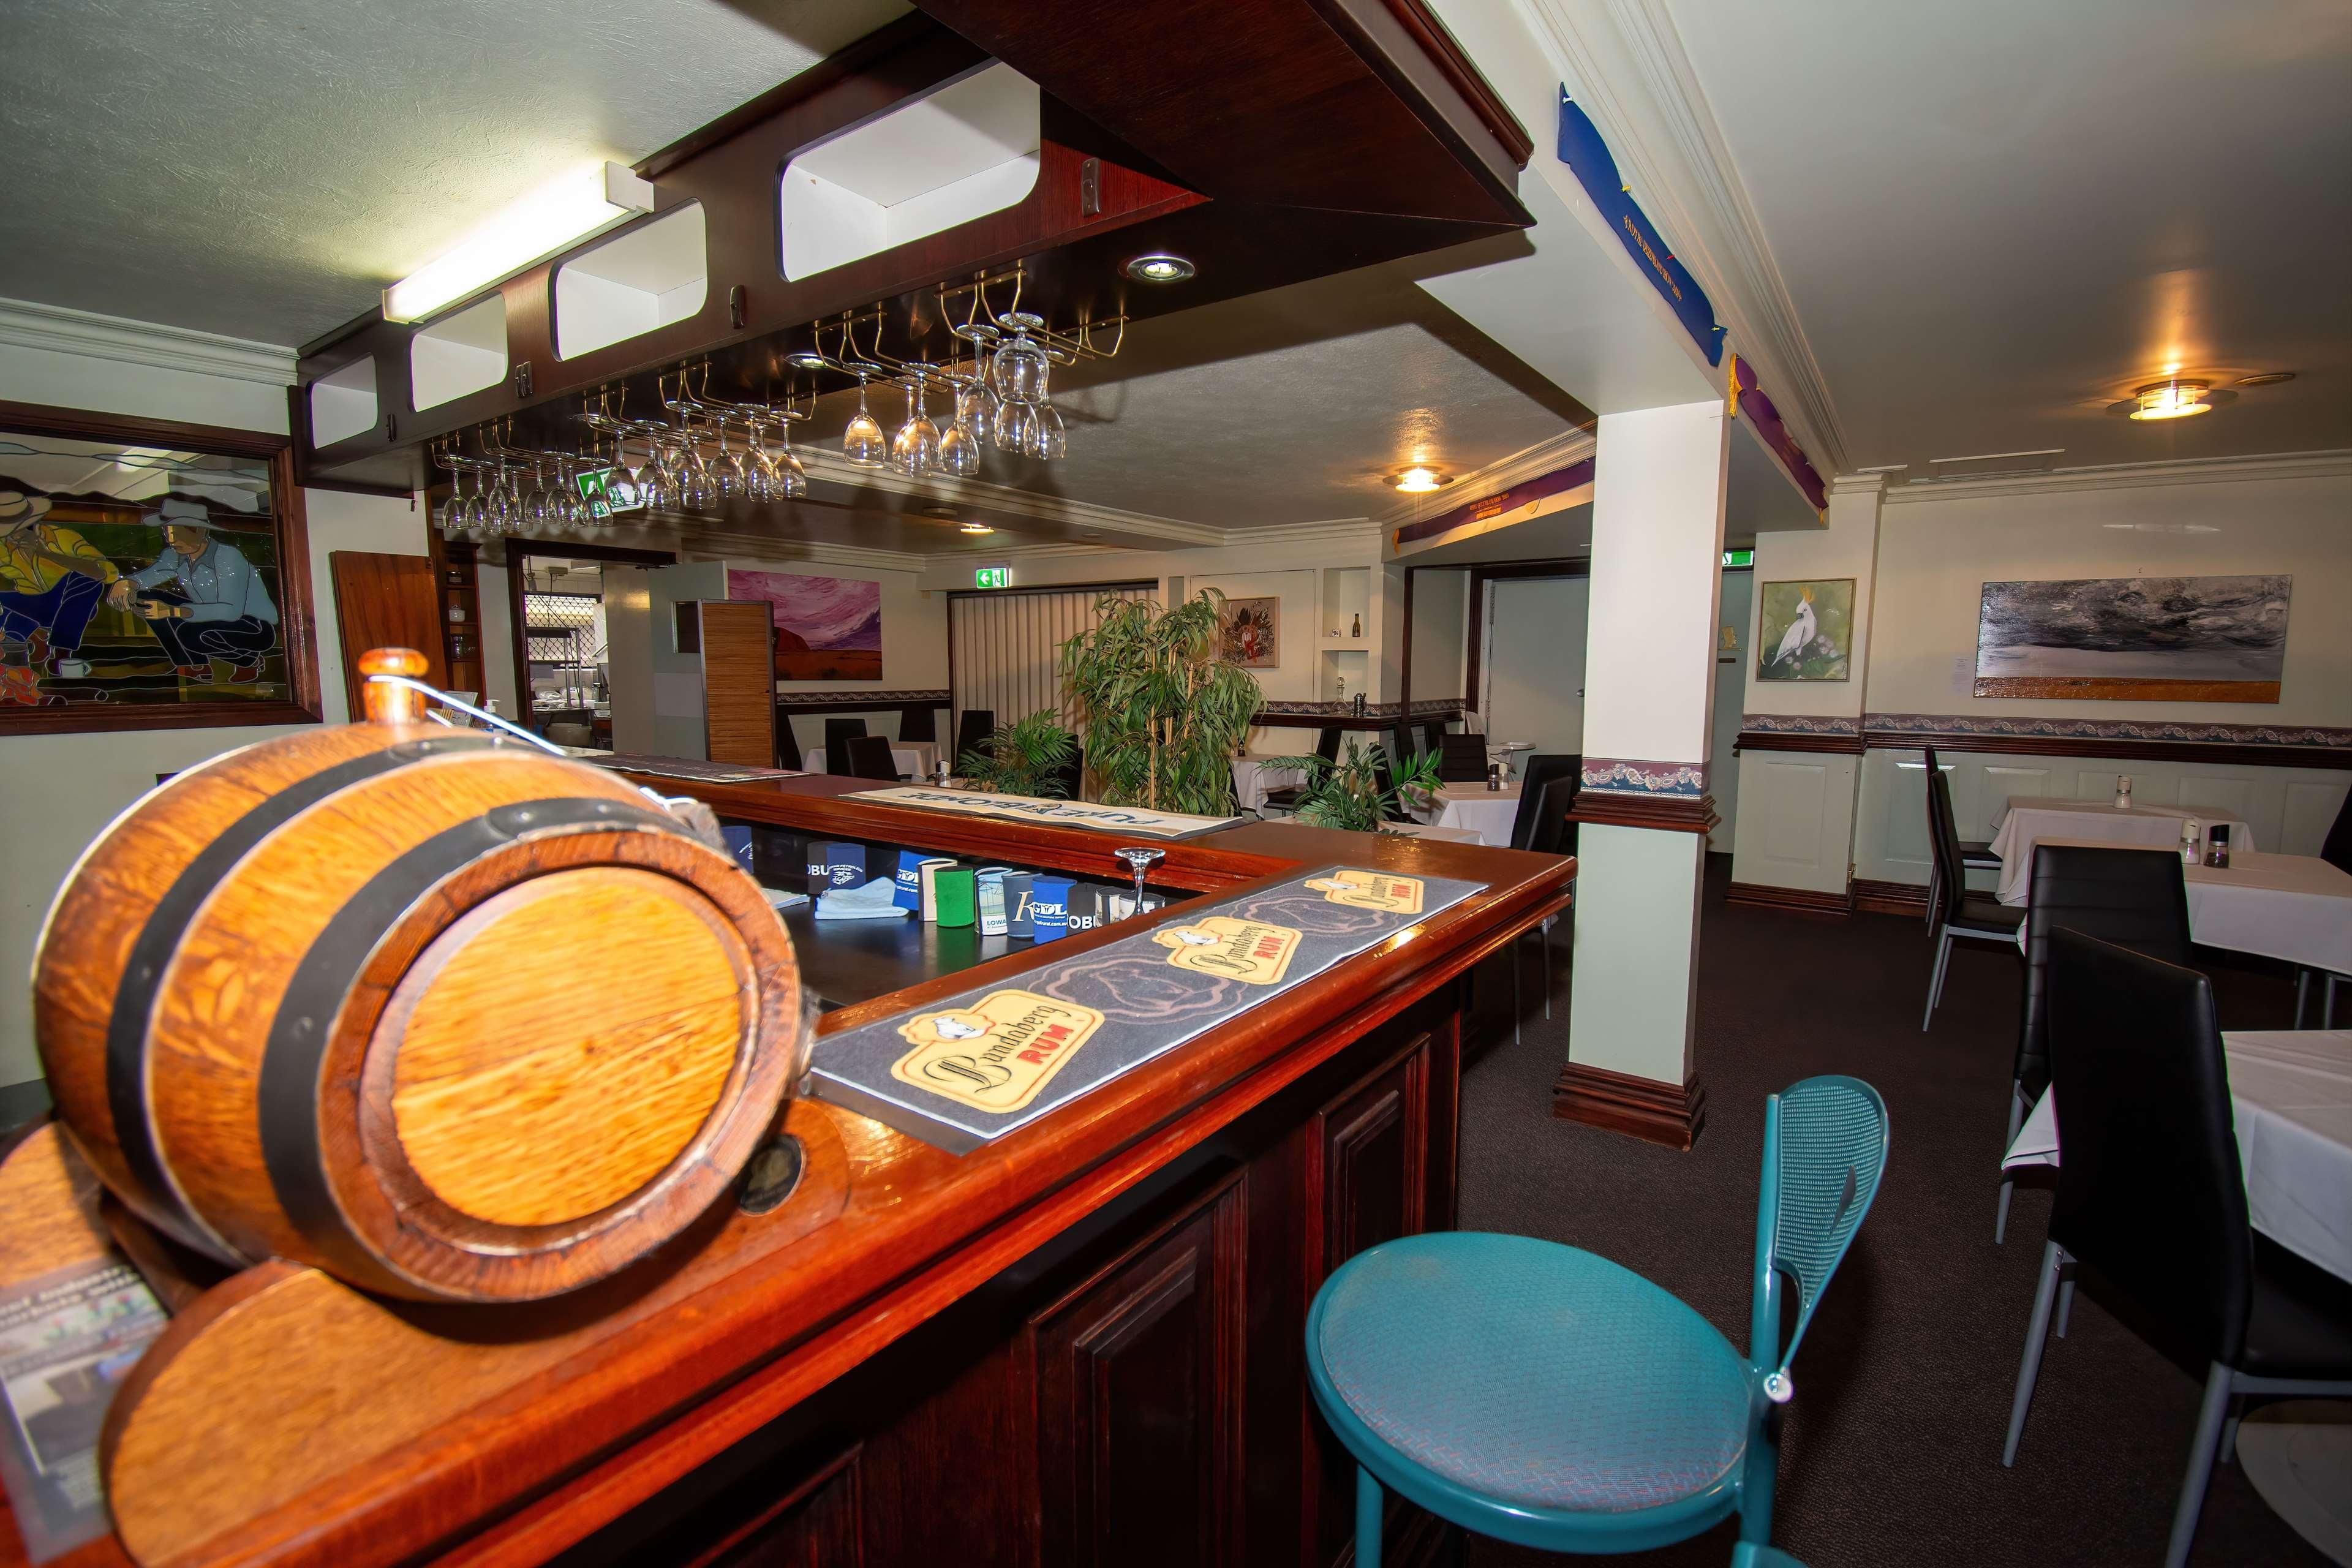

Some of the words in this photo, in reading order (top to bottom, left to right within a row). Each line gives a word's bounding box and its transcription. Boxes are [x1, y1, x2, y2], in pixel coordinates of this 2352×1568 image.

[807, 864, 829, 876] BU
[1190, 925, 1275, 974] Bundaberg
[1253, 936, 1285, 960] RUM
[923, 1005, 1072, 1093] Bundaberg
[1016, 1023, 1074, 1065] RUM
